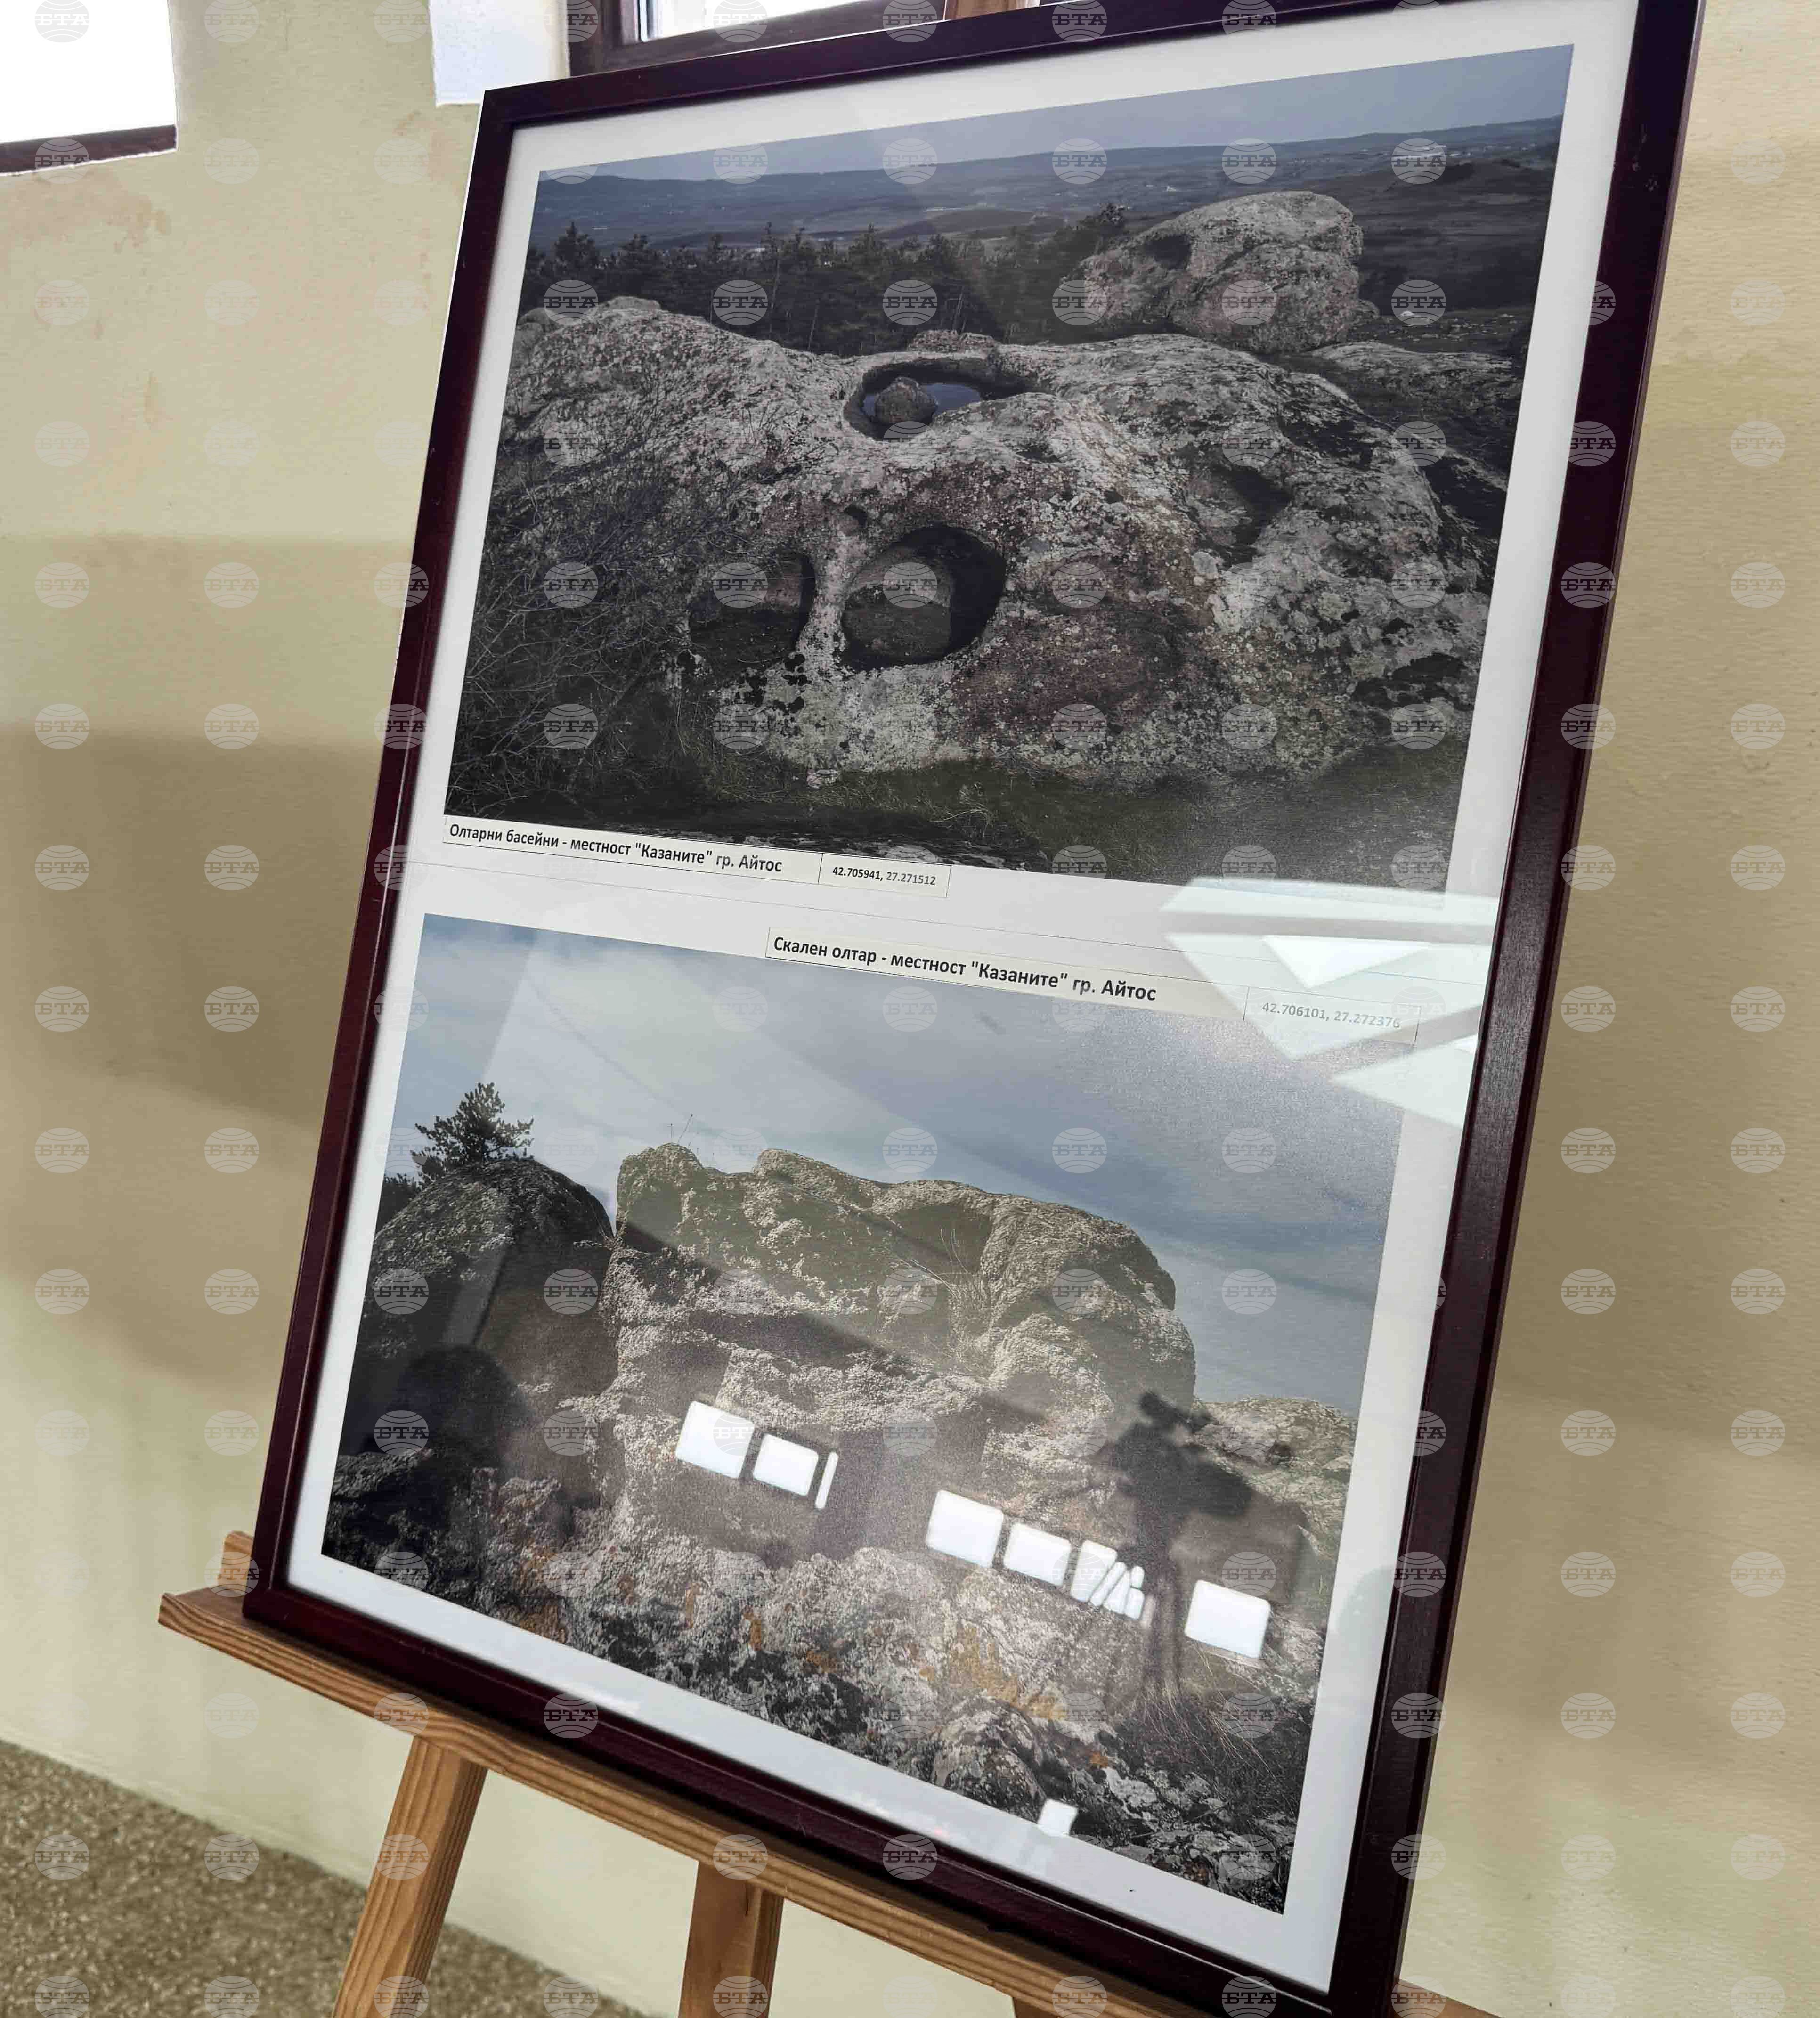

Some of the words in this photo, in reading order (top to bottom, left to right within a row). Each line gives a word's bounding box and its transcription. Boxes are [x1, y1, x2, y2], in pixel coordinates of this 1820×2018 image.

[450, 824, 503, 842] Олтарни
[506, 830, 559, 847] басейни
[570, 839, 631, 855] местност
[635, 842, 712, 864] "Казаните"
[716, 855, 734, 869] гр.
[739, 855, 782, 872] Айтос
[832, 866, 883, 881] 42.705941,
[886, 871, 936, 885] 27.271512
[774, 937, 828, 957] Скален
[832, 947, 877, 966] олтар
[890, 954, 967, 975] местност
[971, 961, 1068, 987] "Казаните"
[1072, 978, 1096, 995] гр.
[1101, 980, 1157, 1001] Айтос
[1262, 1002, 1329, 1022] 42.706101,
[1333, 1010, 1400, 1029] 27.272376
